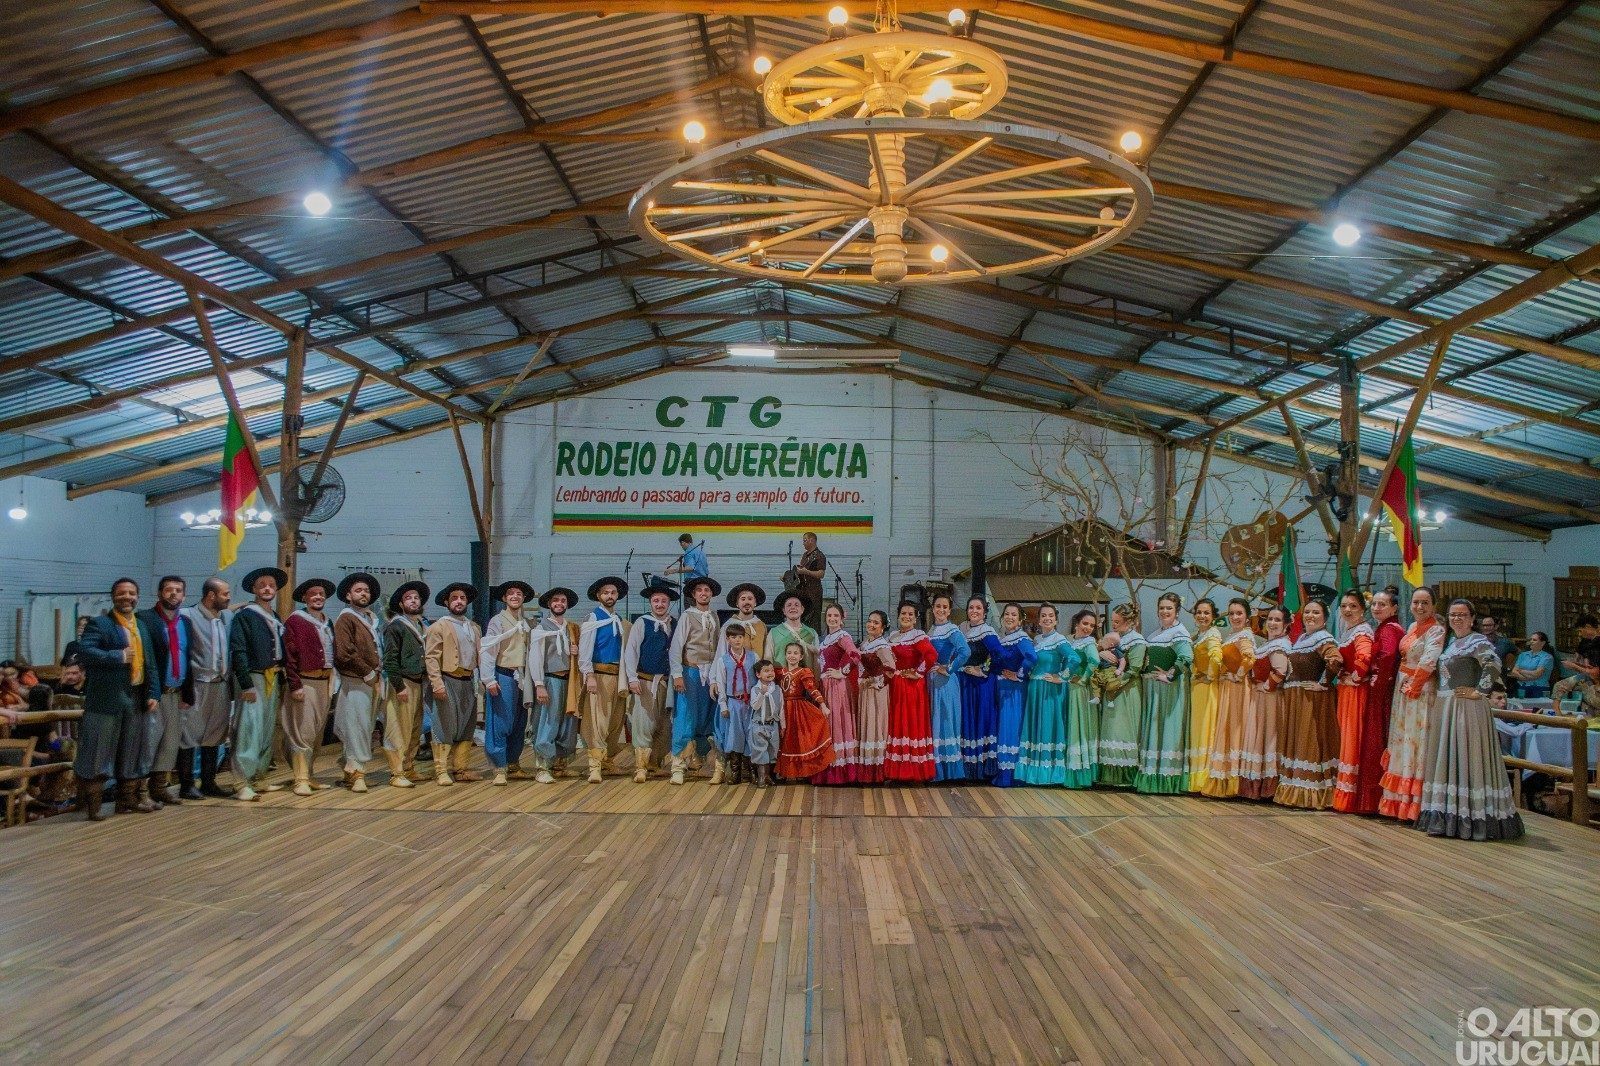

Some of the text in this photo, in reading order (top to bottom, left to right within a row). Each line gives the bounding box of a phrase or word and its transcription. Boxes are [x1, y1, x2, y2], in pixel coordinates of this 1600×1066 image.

[556, 436, 868, 481] RODEIO DA QUERÊNCIA
[556, 486, 865, 509] Lembrando o passado para exemplo do futuro.
